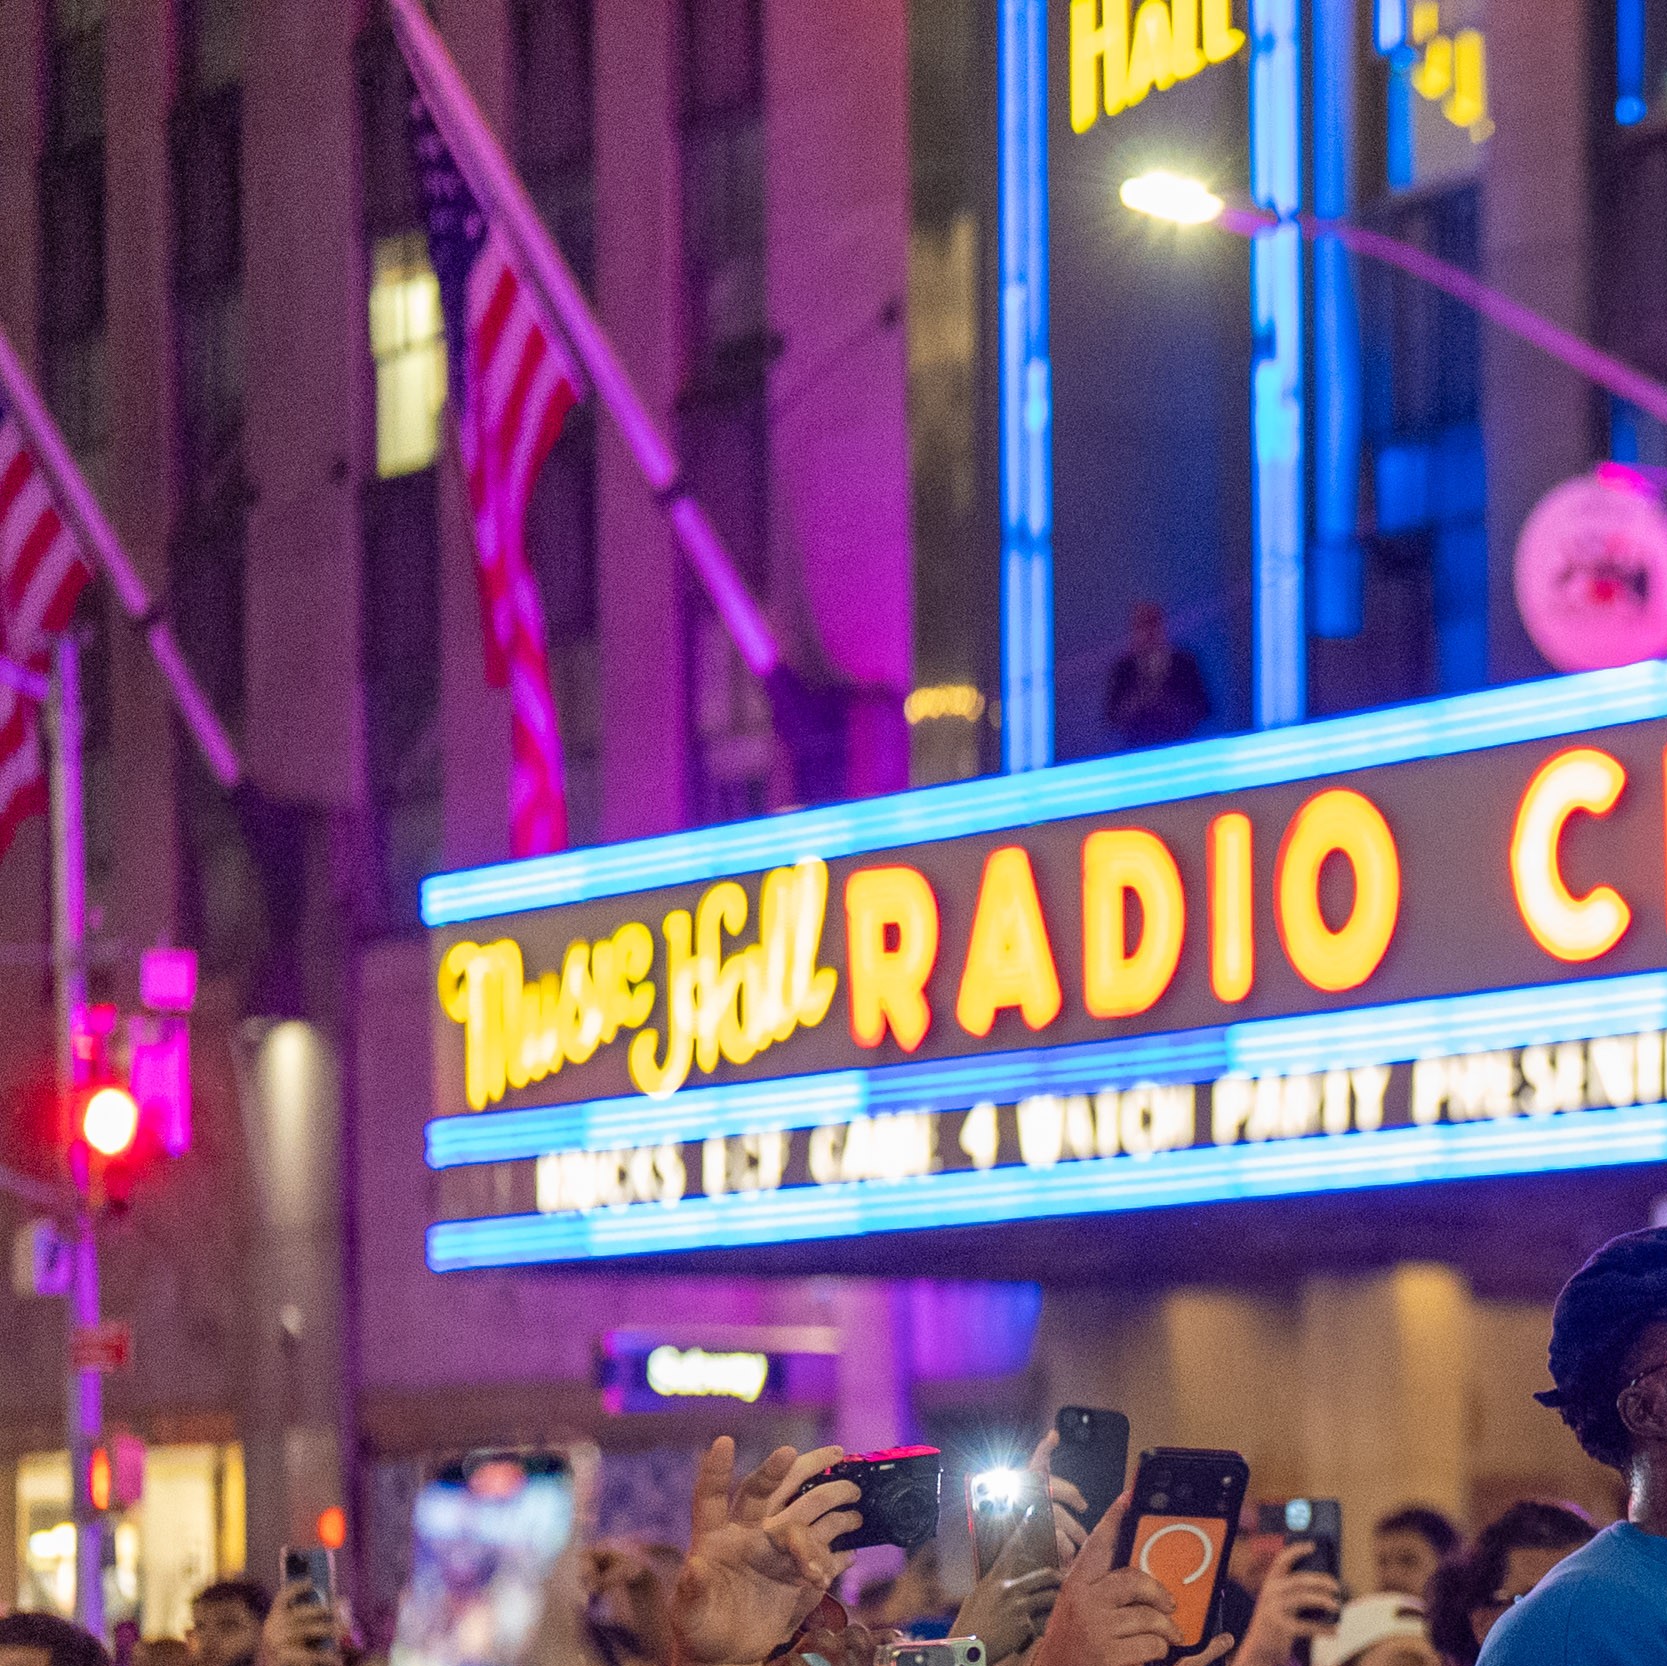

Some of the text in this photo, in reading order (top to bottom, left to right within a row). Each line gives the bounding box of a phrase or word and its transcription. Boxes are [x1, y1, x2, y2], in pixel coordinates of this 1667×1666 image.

[439, 856, 836, 1111] Music Hall
[845, 787, 1400, 1051] RADIO
[535, 1142, 686, 1214] KNICKS
[808, 1112, 939, 1186] GAME
[959, 1102, 999, 1169] 4
[1016, 1082, 1196, 1168] WATCH
[1211, 1066, 1391, 1145] PARTY
